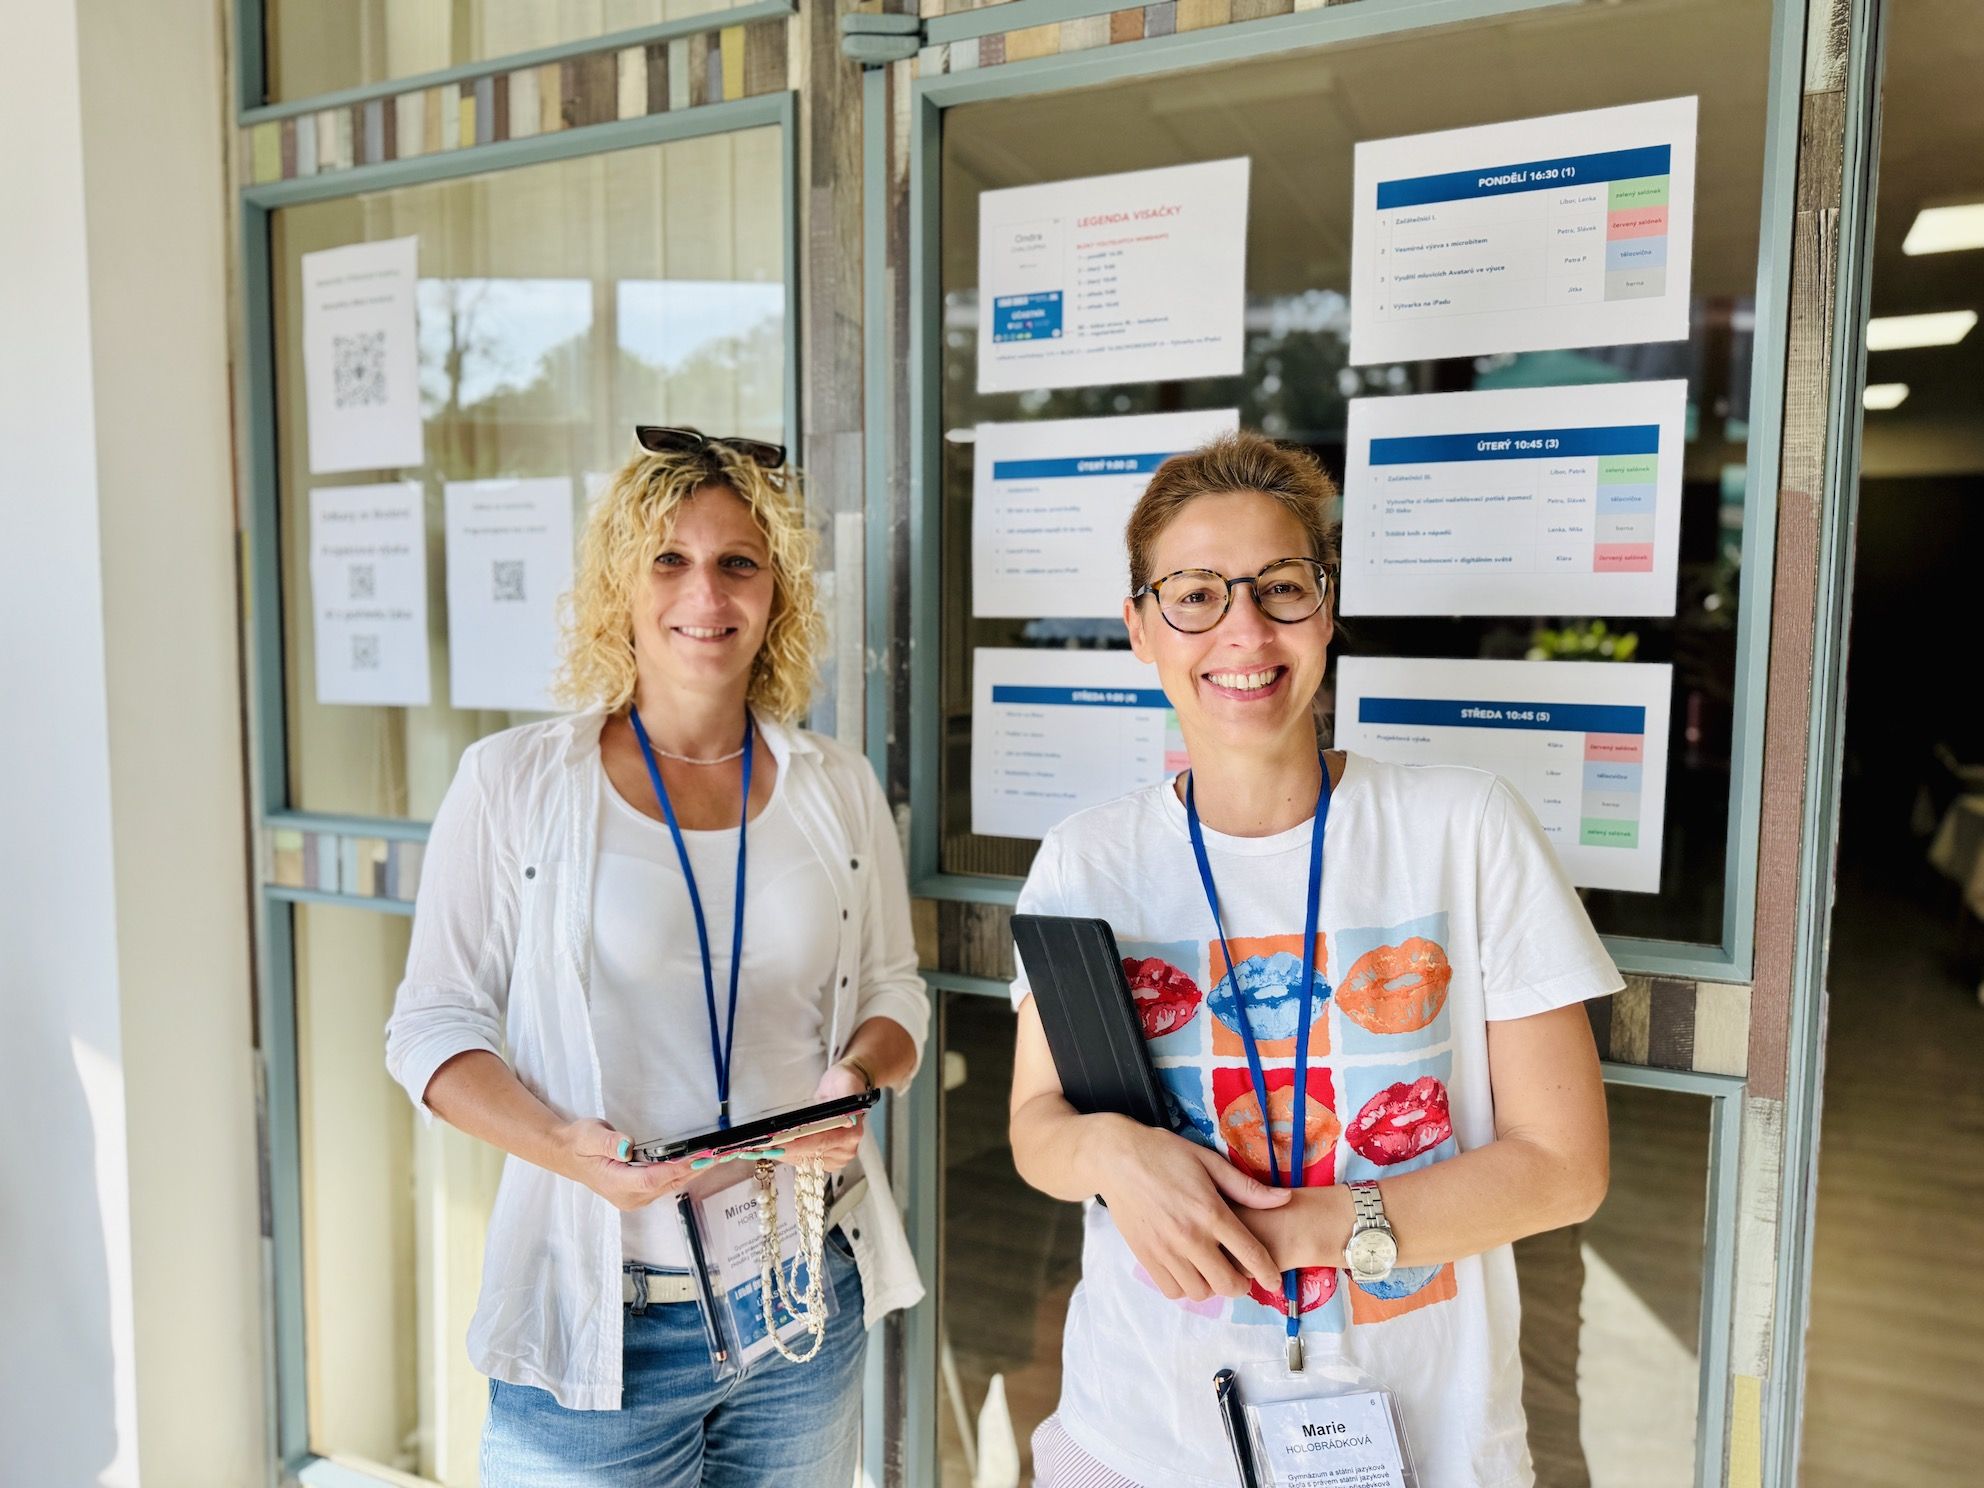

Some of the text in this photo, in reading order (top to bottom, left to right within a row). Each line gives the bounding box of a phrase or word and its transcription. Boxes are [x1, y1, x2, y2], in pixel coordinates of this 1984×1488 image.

[1478, 166, 1576, 188] PONDĚLÍ 16:30 (1)
[1615, 190, 1636, 199] zelený
[1077, 205, 1183, 228] LEGENDA VISAČKY
[1612, 220, 1637, 229] červený
[1451, 237, 1488, 247] microbitem
[1485, 264, 1505, 272] výuce
[1477, 438, 1560, 452] ÚTERÝ 10:45 (3)
[1460, 707, 1550, 722] STŘEDA 10:45 (5)
[1302, 1421, 1346, 1438] Marie
[1286, 1434, 1373, 1454] HOLOBRÁDKOVÁ
[1288, 1470, 1328, 1482] Gymnázium
[1335, 1466, 1354, 1475] státní
[1355, 1463, 1385, 1475] jazyková
[1313, 1476, 1339, 1488] právem
[1339, 1473, 1358, 1483] státní
[1359, 1471, 1390, 1483] jazykové
